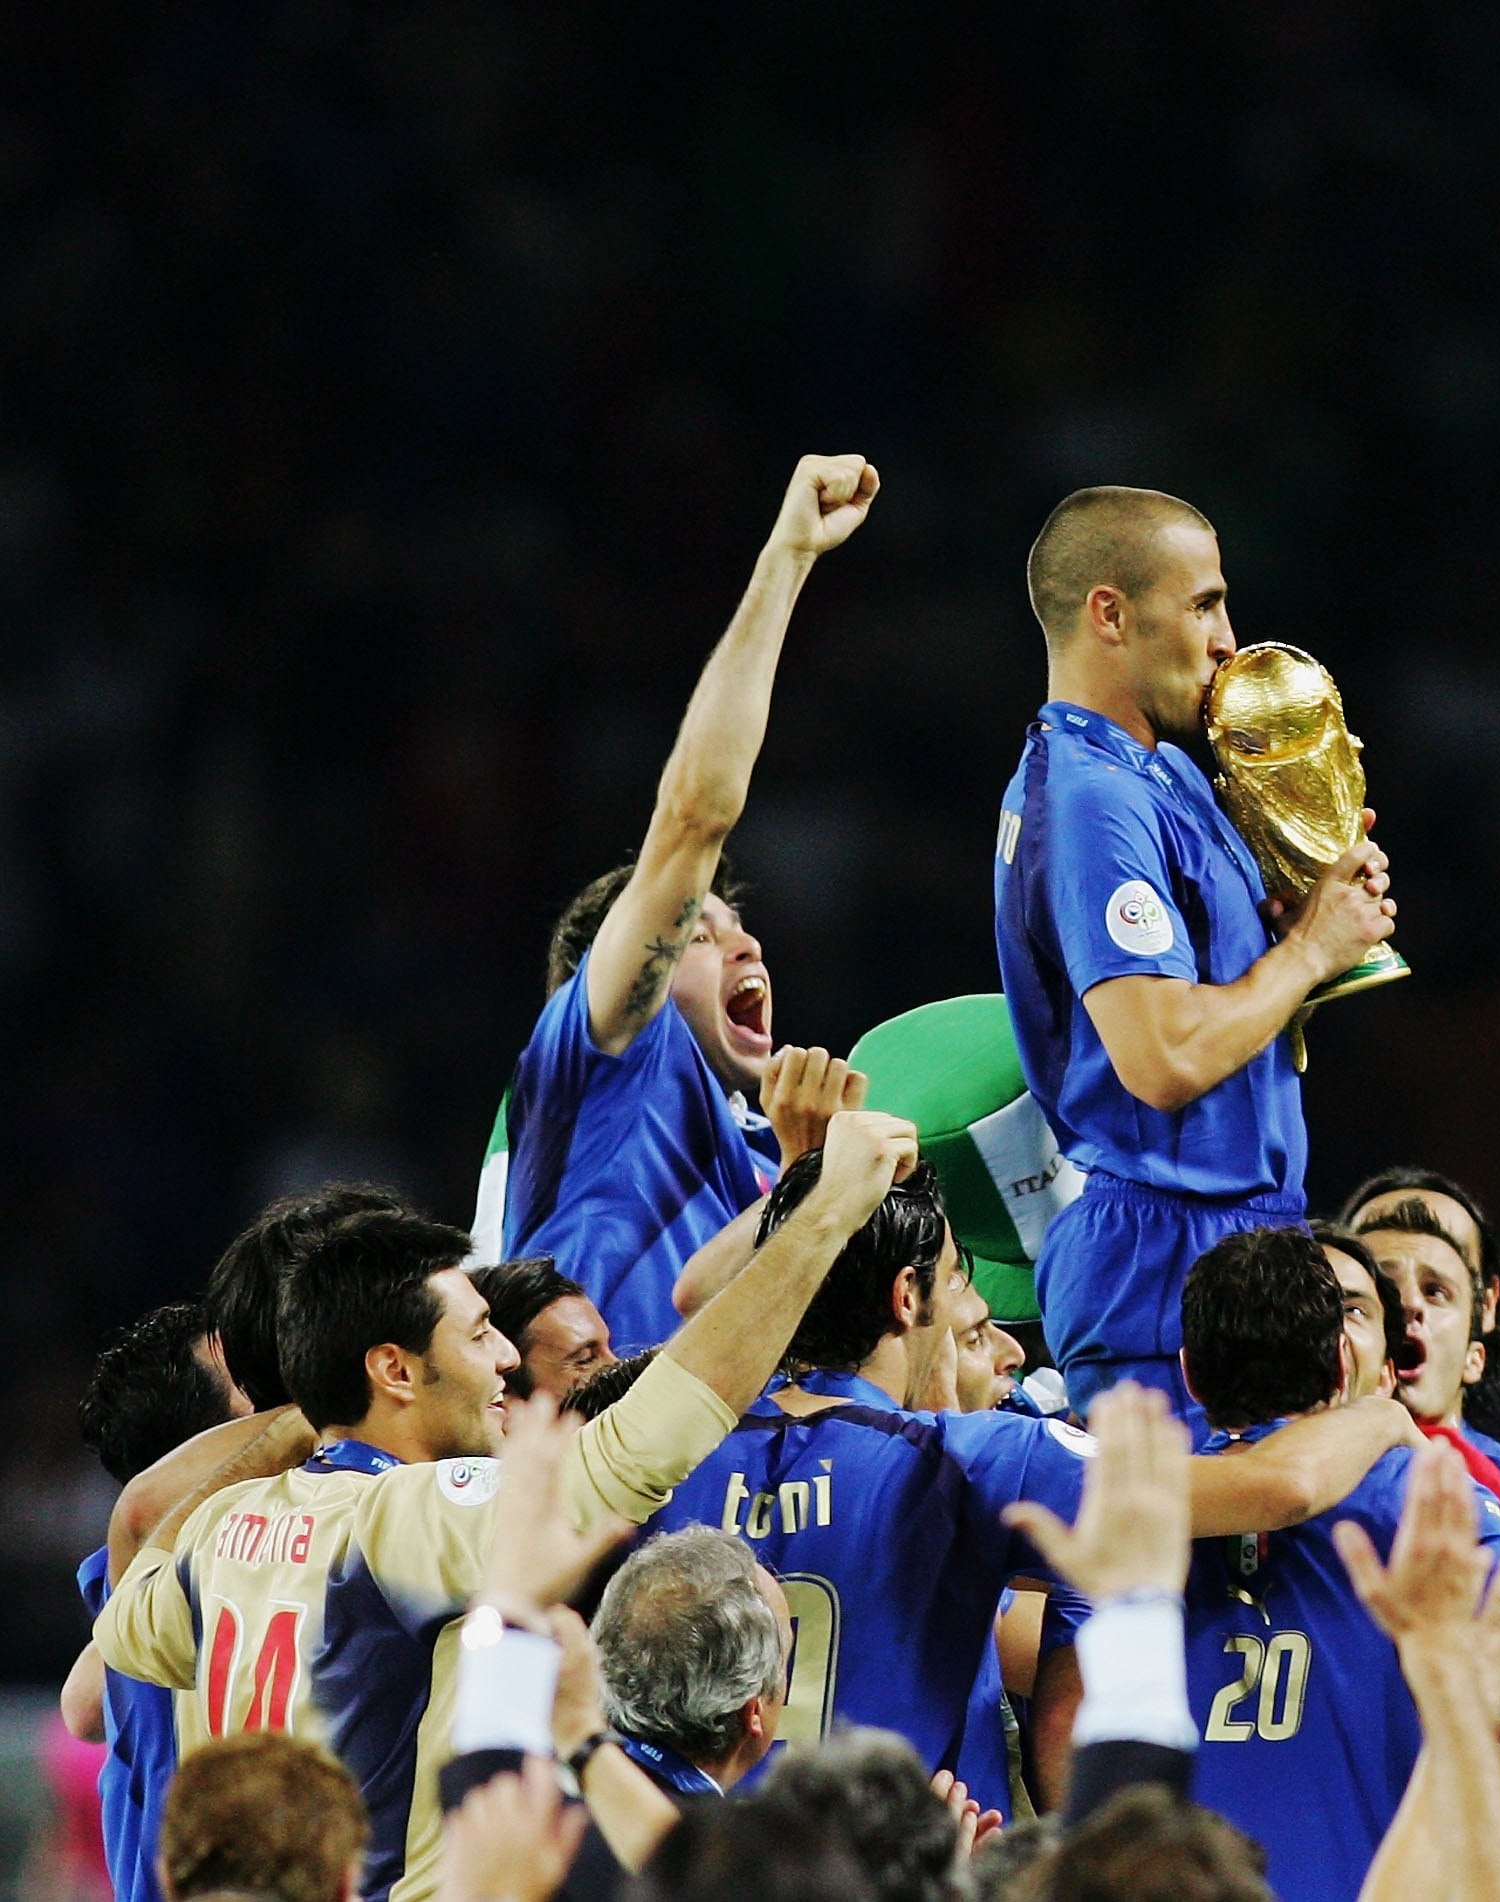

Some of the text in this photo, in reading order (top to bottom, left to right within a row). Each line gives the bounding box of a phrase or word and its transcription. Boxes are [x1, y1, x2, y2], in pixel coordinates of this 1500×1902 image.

[370, 1456, 392, 1470] FIF
[721, 1458, 833, 1540] toni
[1204, 1629, 1312, 1743] 20
